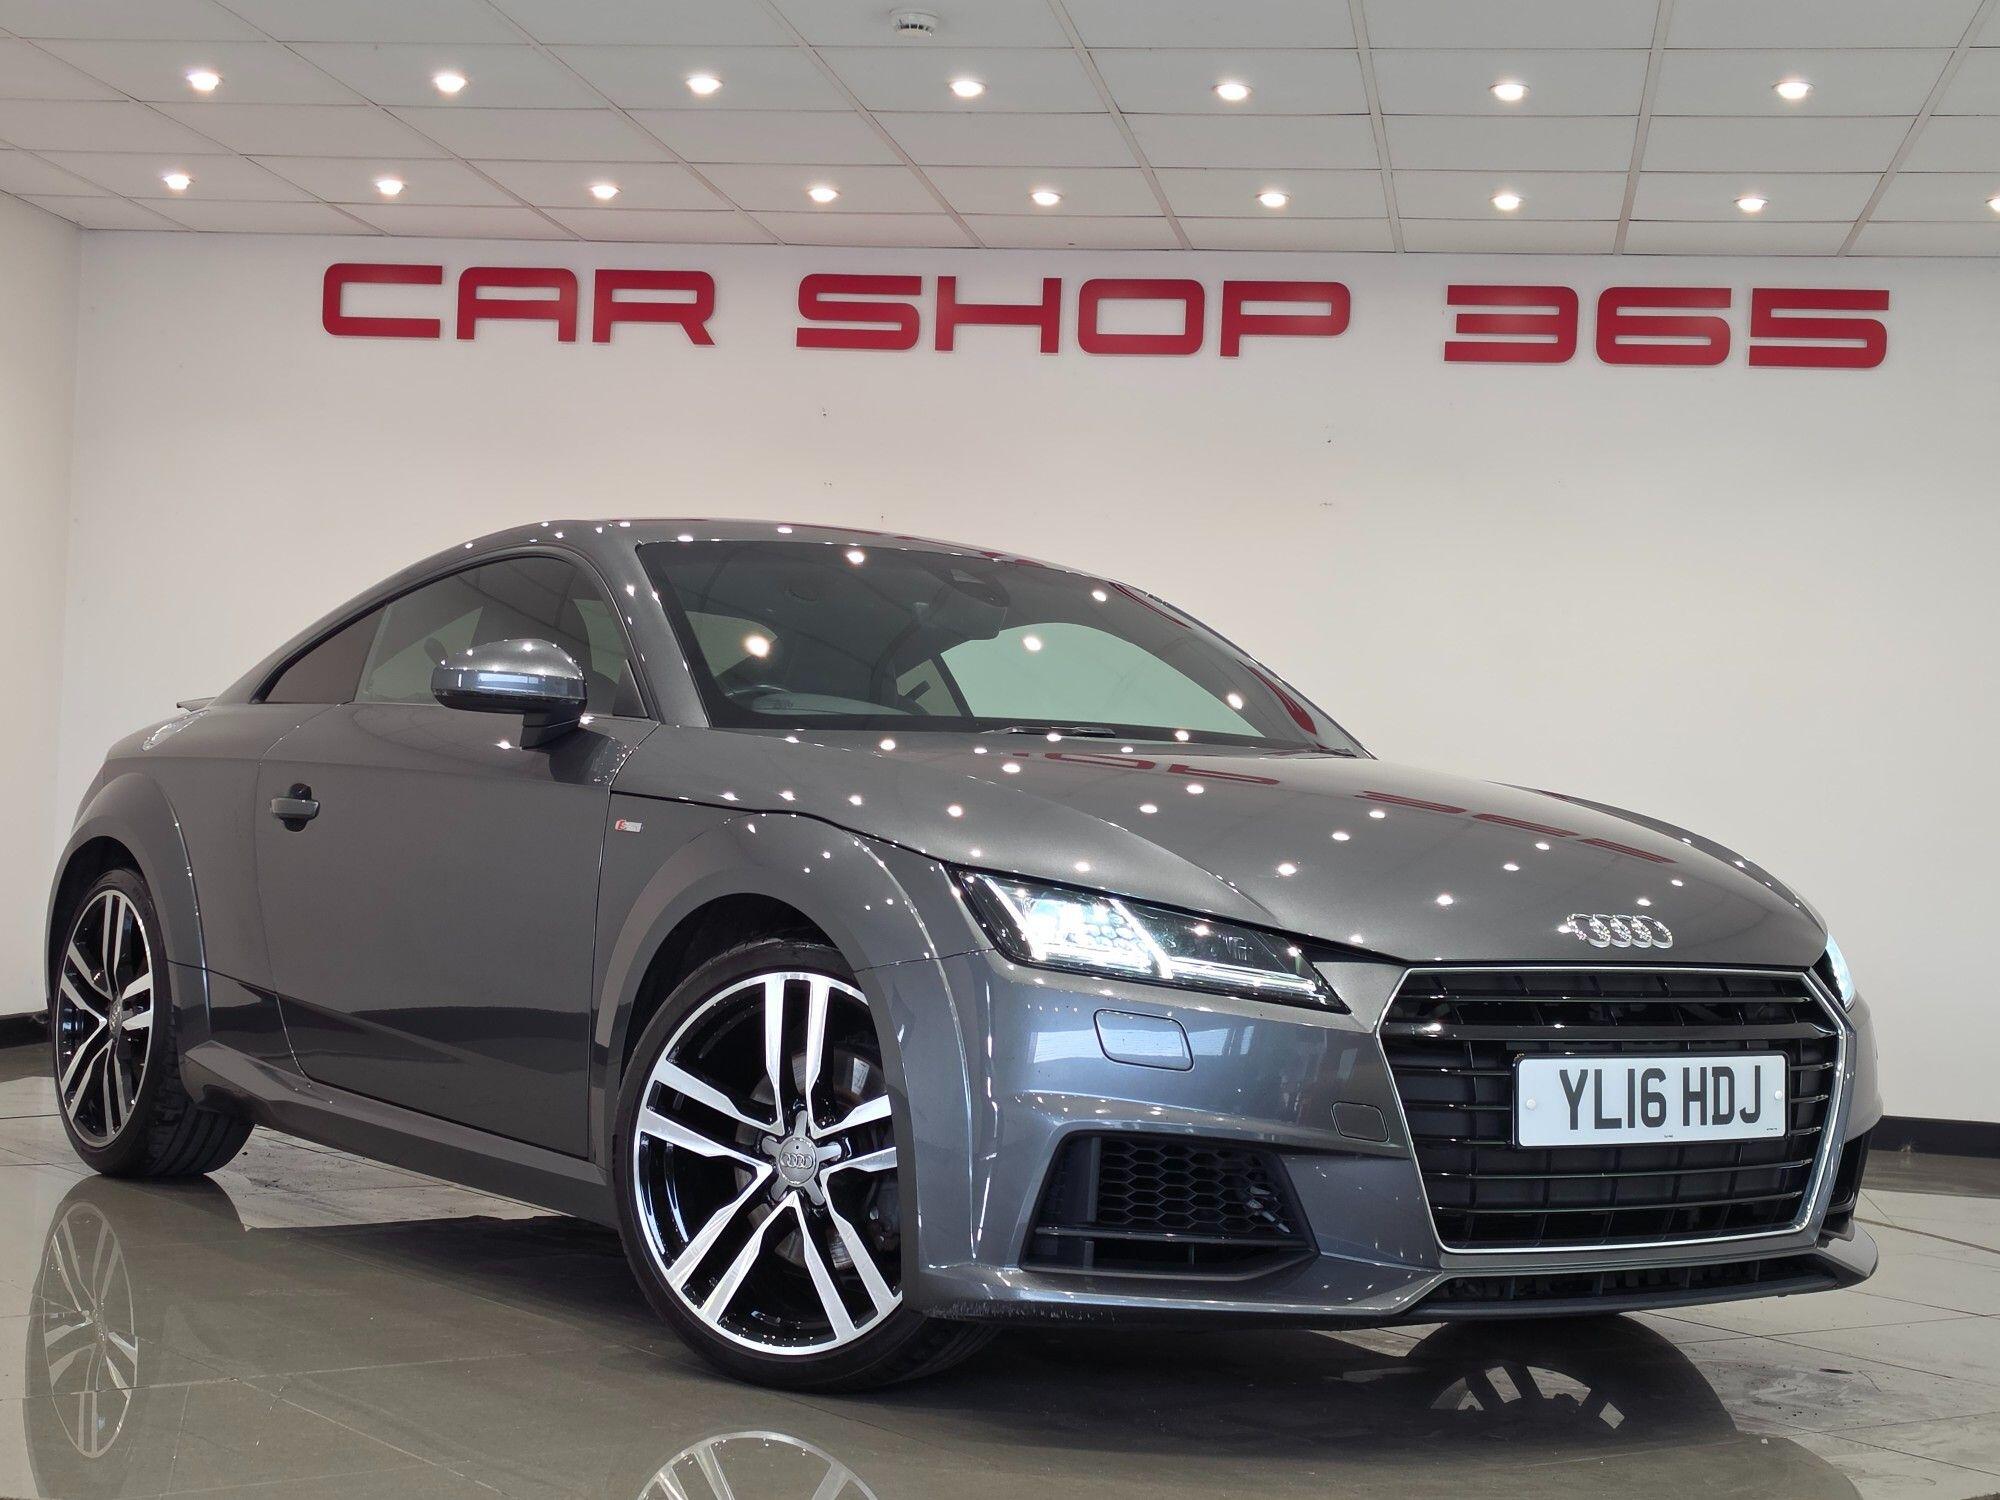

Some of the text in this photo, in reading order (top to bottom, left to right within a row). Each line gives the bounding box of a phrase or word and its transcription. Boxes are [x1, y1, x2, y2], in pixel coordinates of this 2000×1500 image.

[322, 263, 1889, 369] CAR SHOP 365
[1558, 1065, 1762, 1131] YL16 HDJ
